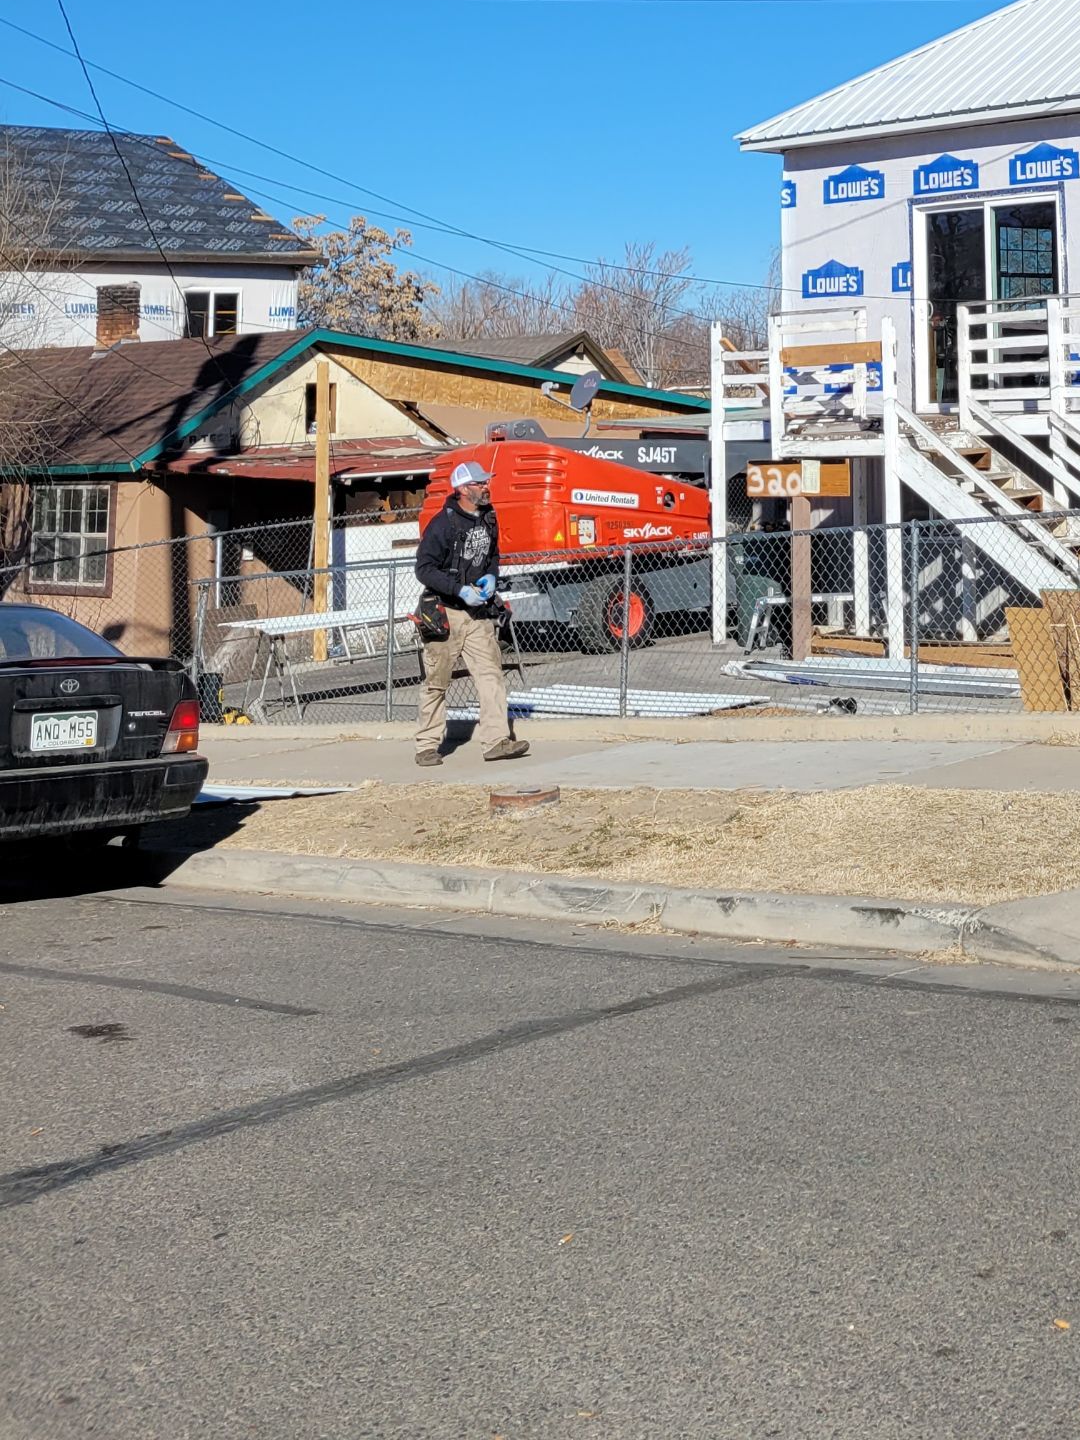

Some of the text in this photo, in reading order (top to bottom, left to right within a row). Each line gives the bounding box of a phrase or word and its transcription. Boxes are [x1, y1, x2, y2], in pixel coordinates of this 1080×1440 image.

[1016, 155, 1073, 181] LOWE'S
[829, 176, 879, 200] LOWE'S
[920, 167, 973, 191] LOWE'S
[808, 273, 859, 294] LOWE'S
[65, 303, 97, 314] LUMB
[269, 306, 295, 317] LUMB
[637, 446, 678, 464] SJ45T
[747, 465, 802, 497] 320
[585, 492, 636, 505] United Rentals
[623, 522, 673, 539] SKYJACK
[47, 739, 80, 747] COLORADO
